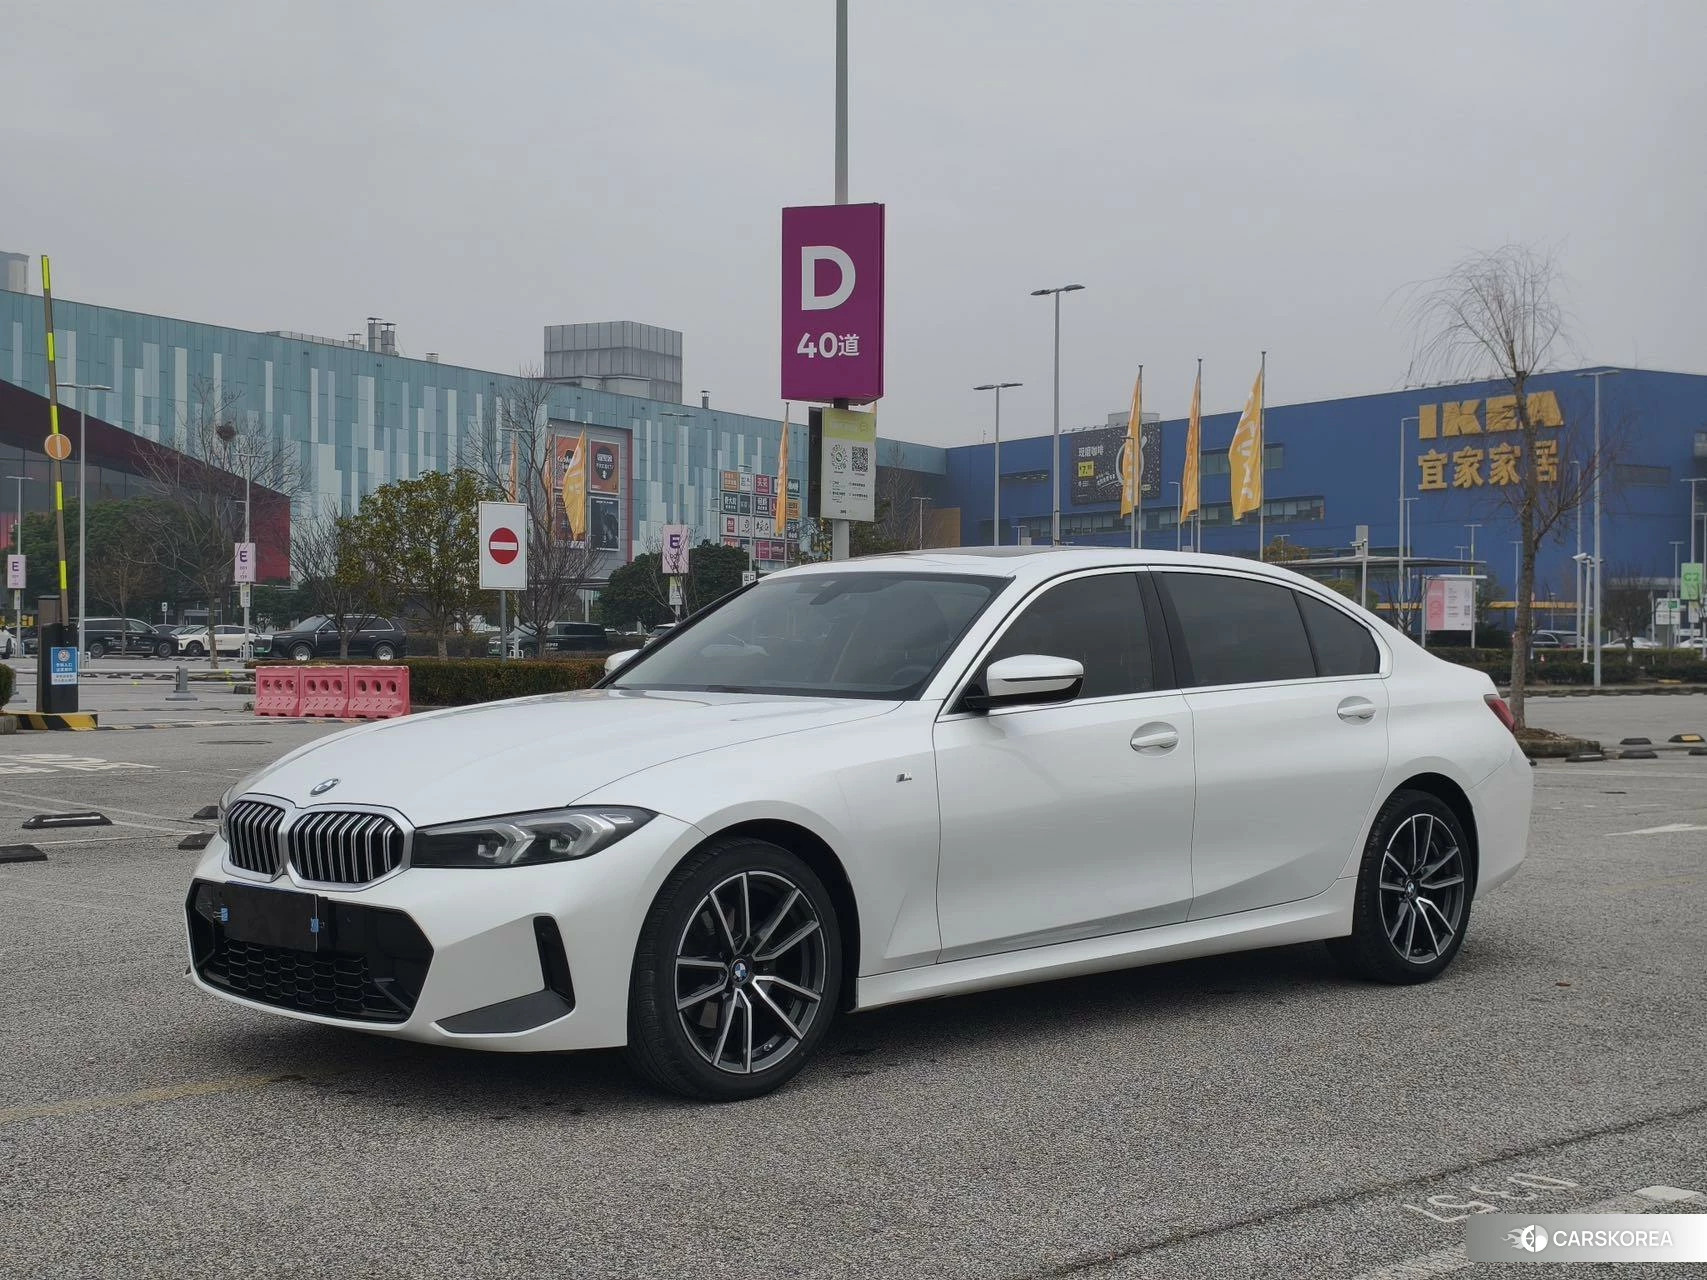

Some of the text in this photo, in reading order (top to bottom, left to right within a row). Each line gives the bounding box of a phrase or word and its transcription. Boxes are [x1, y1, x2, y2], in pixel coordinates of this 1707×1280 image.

[801, 246, 855, 310] D
[797, 332, 859, 358] 40道
[1418, 391, 1564, 440] IKEA
[1417, 440, 1560, 491] 宜家家居
[670, 534, 680, 548] E
[12, 561, 19, 571] E
[240, 551, 248, 562] E
